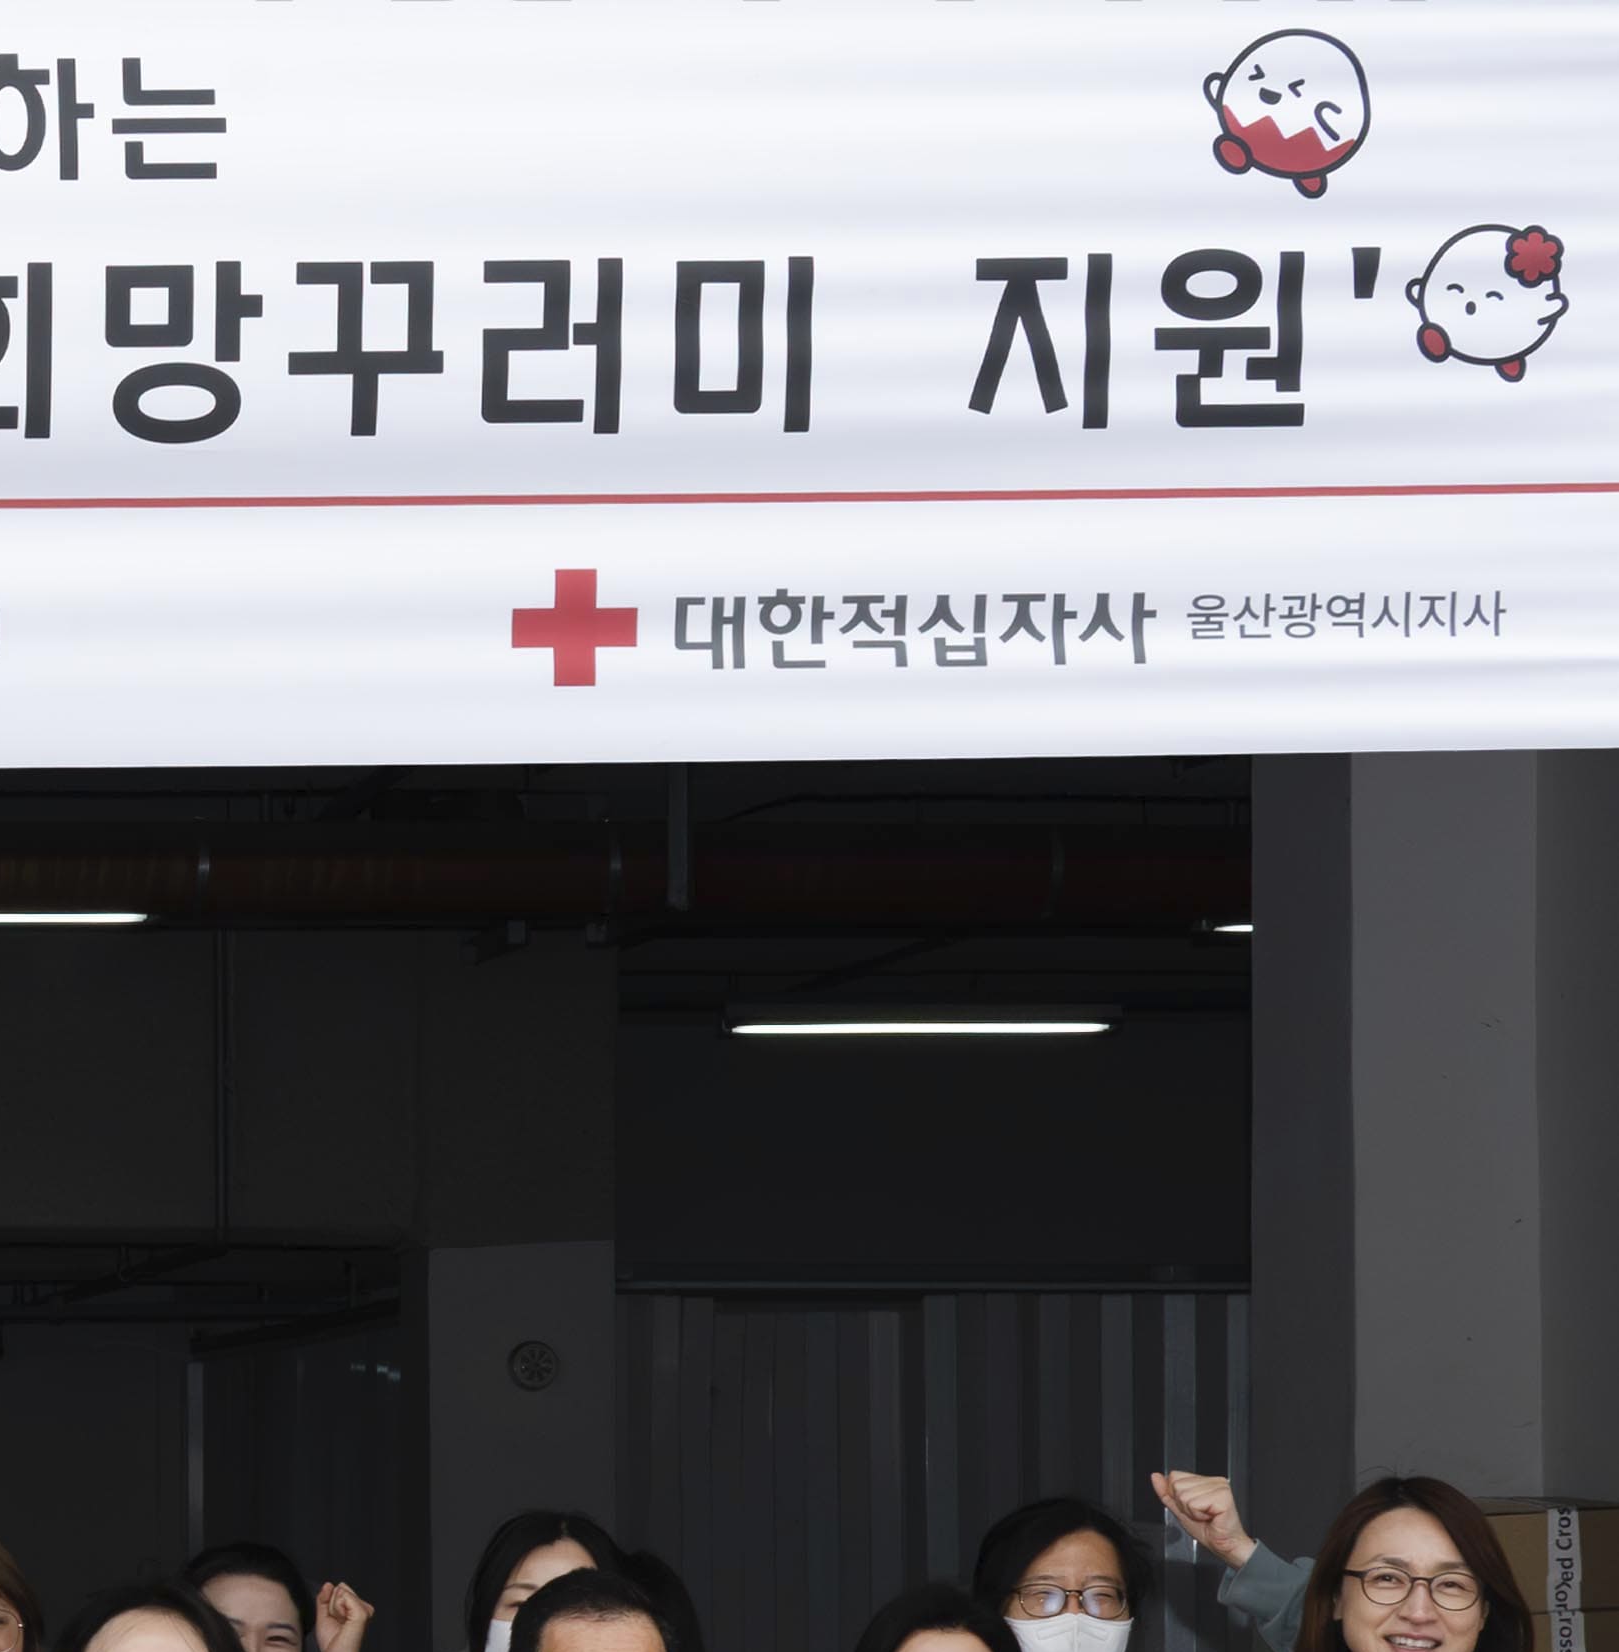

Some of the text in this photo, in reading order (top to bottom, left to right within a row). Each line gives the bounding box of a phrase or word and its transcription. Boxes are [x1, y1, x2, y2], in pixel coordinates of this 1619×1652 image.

[967, 246, 1382, 430] 지원'
[674, 588, 1158, 670] 대한적십자사
[1186, 590, 1508, 640] 울산광역시지사
[1556, 1556, 1574, 1582] ed
